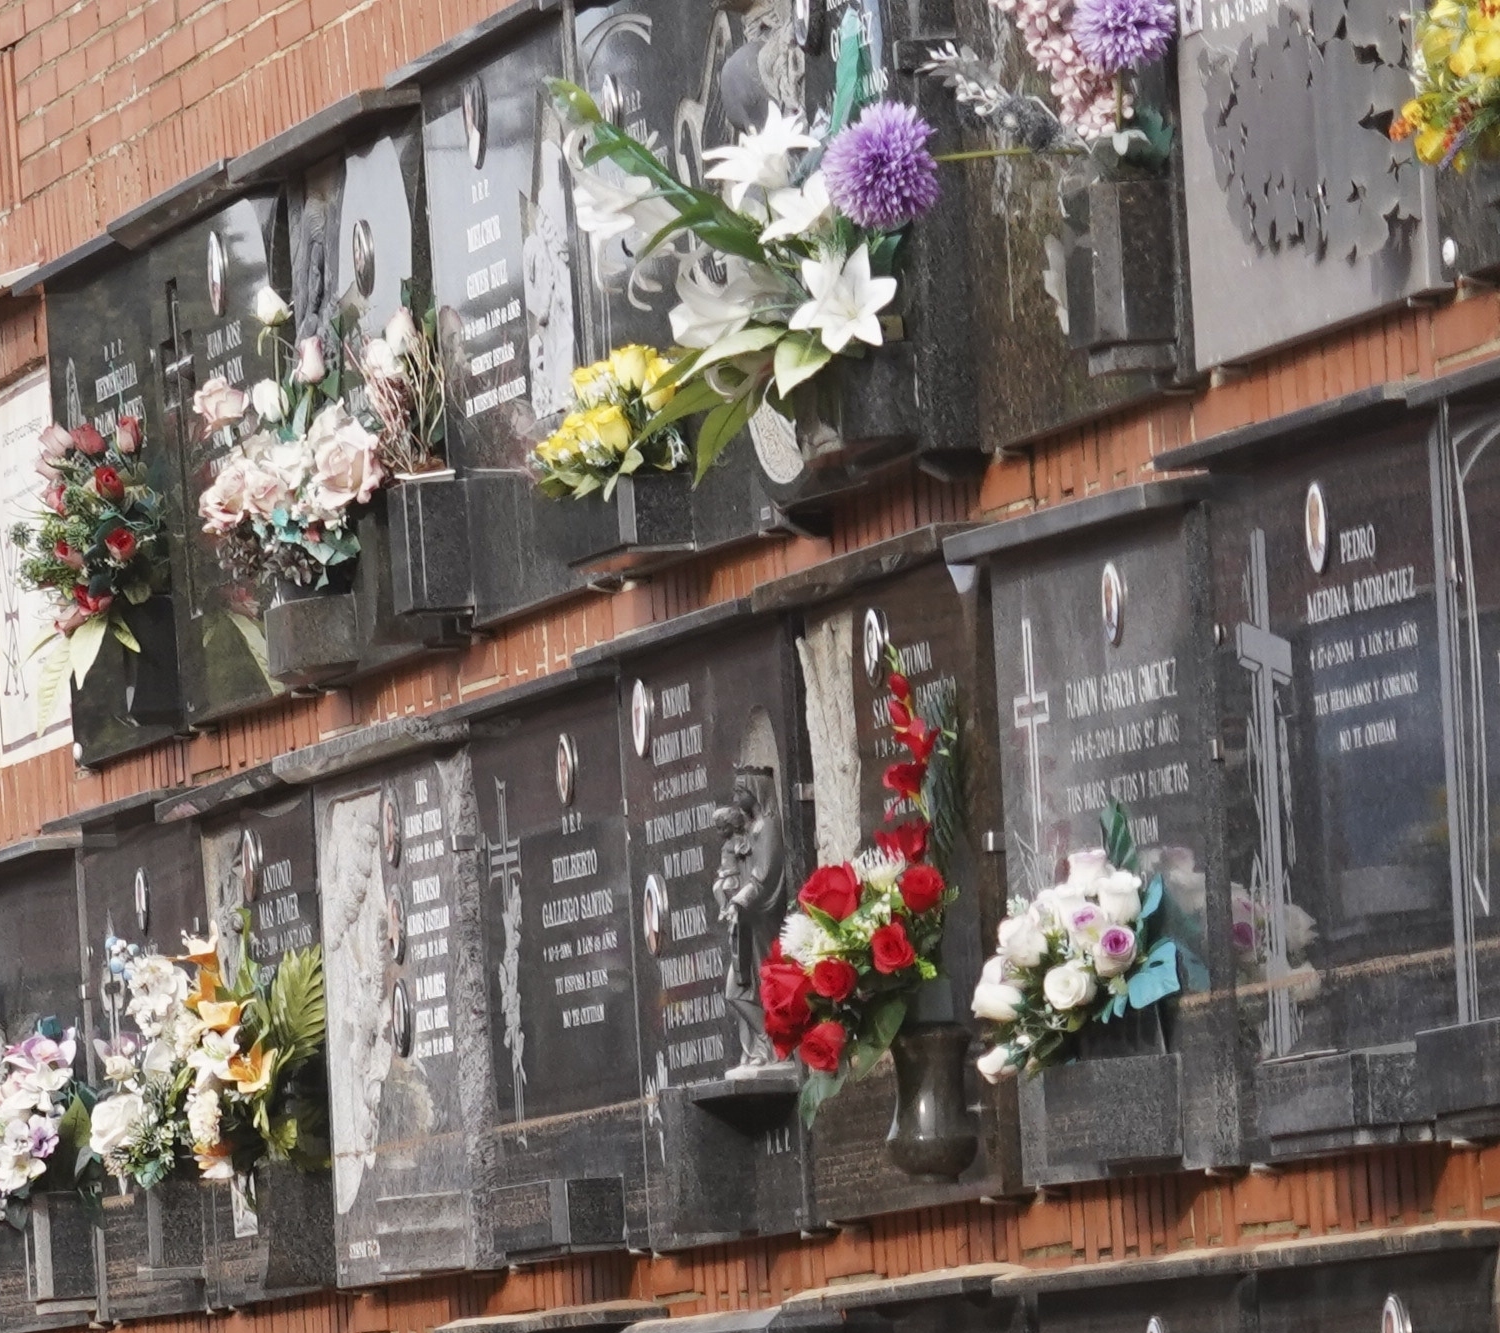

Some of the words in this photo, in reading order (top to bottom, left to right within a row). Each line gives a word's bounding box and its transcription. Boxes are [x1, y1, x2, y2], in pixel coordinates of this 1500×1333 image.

[1340, 522, 1376, 564] PEDRO
[1306, 584, 1351, 625] MEDINA
[1353, 565, 1416, 612] RODRIGUEZ
